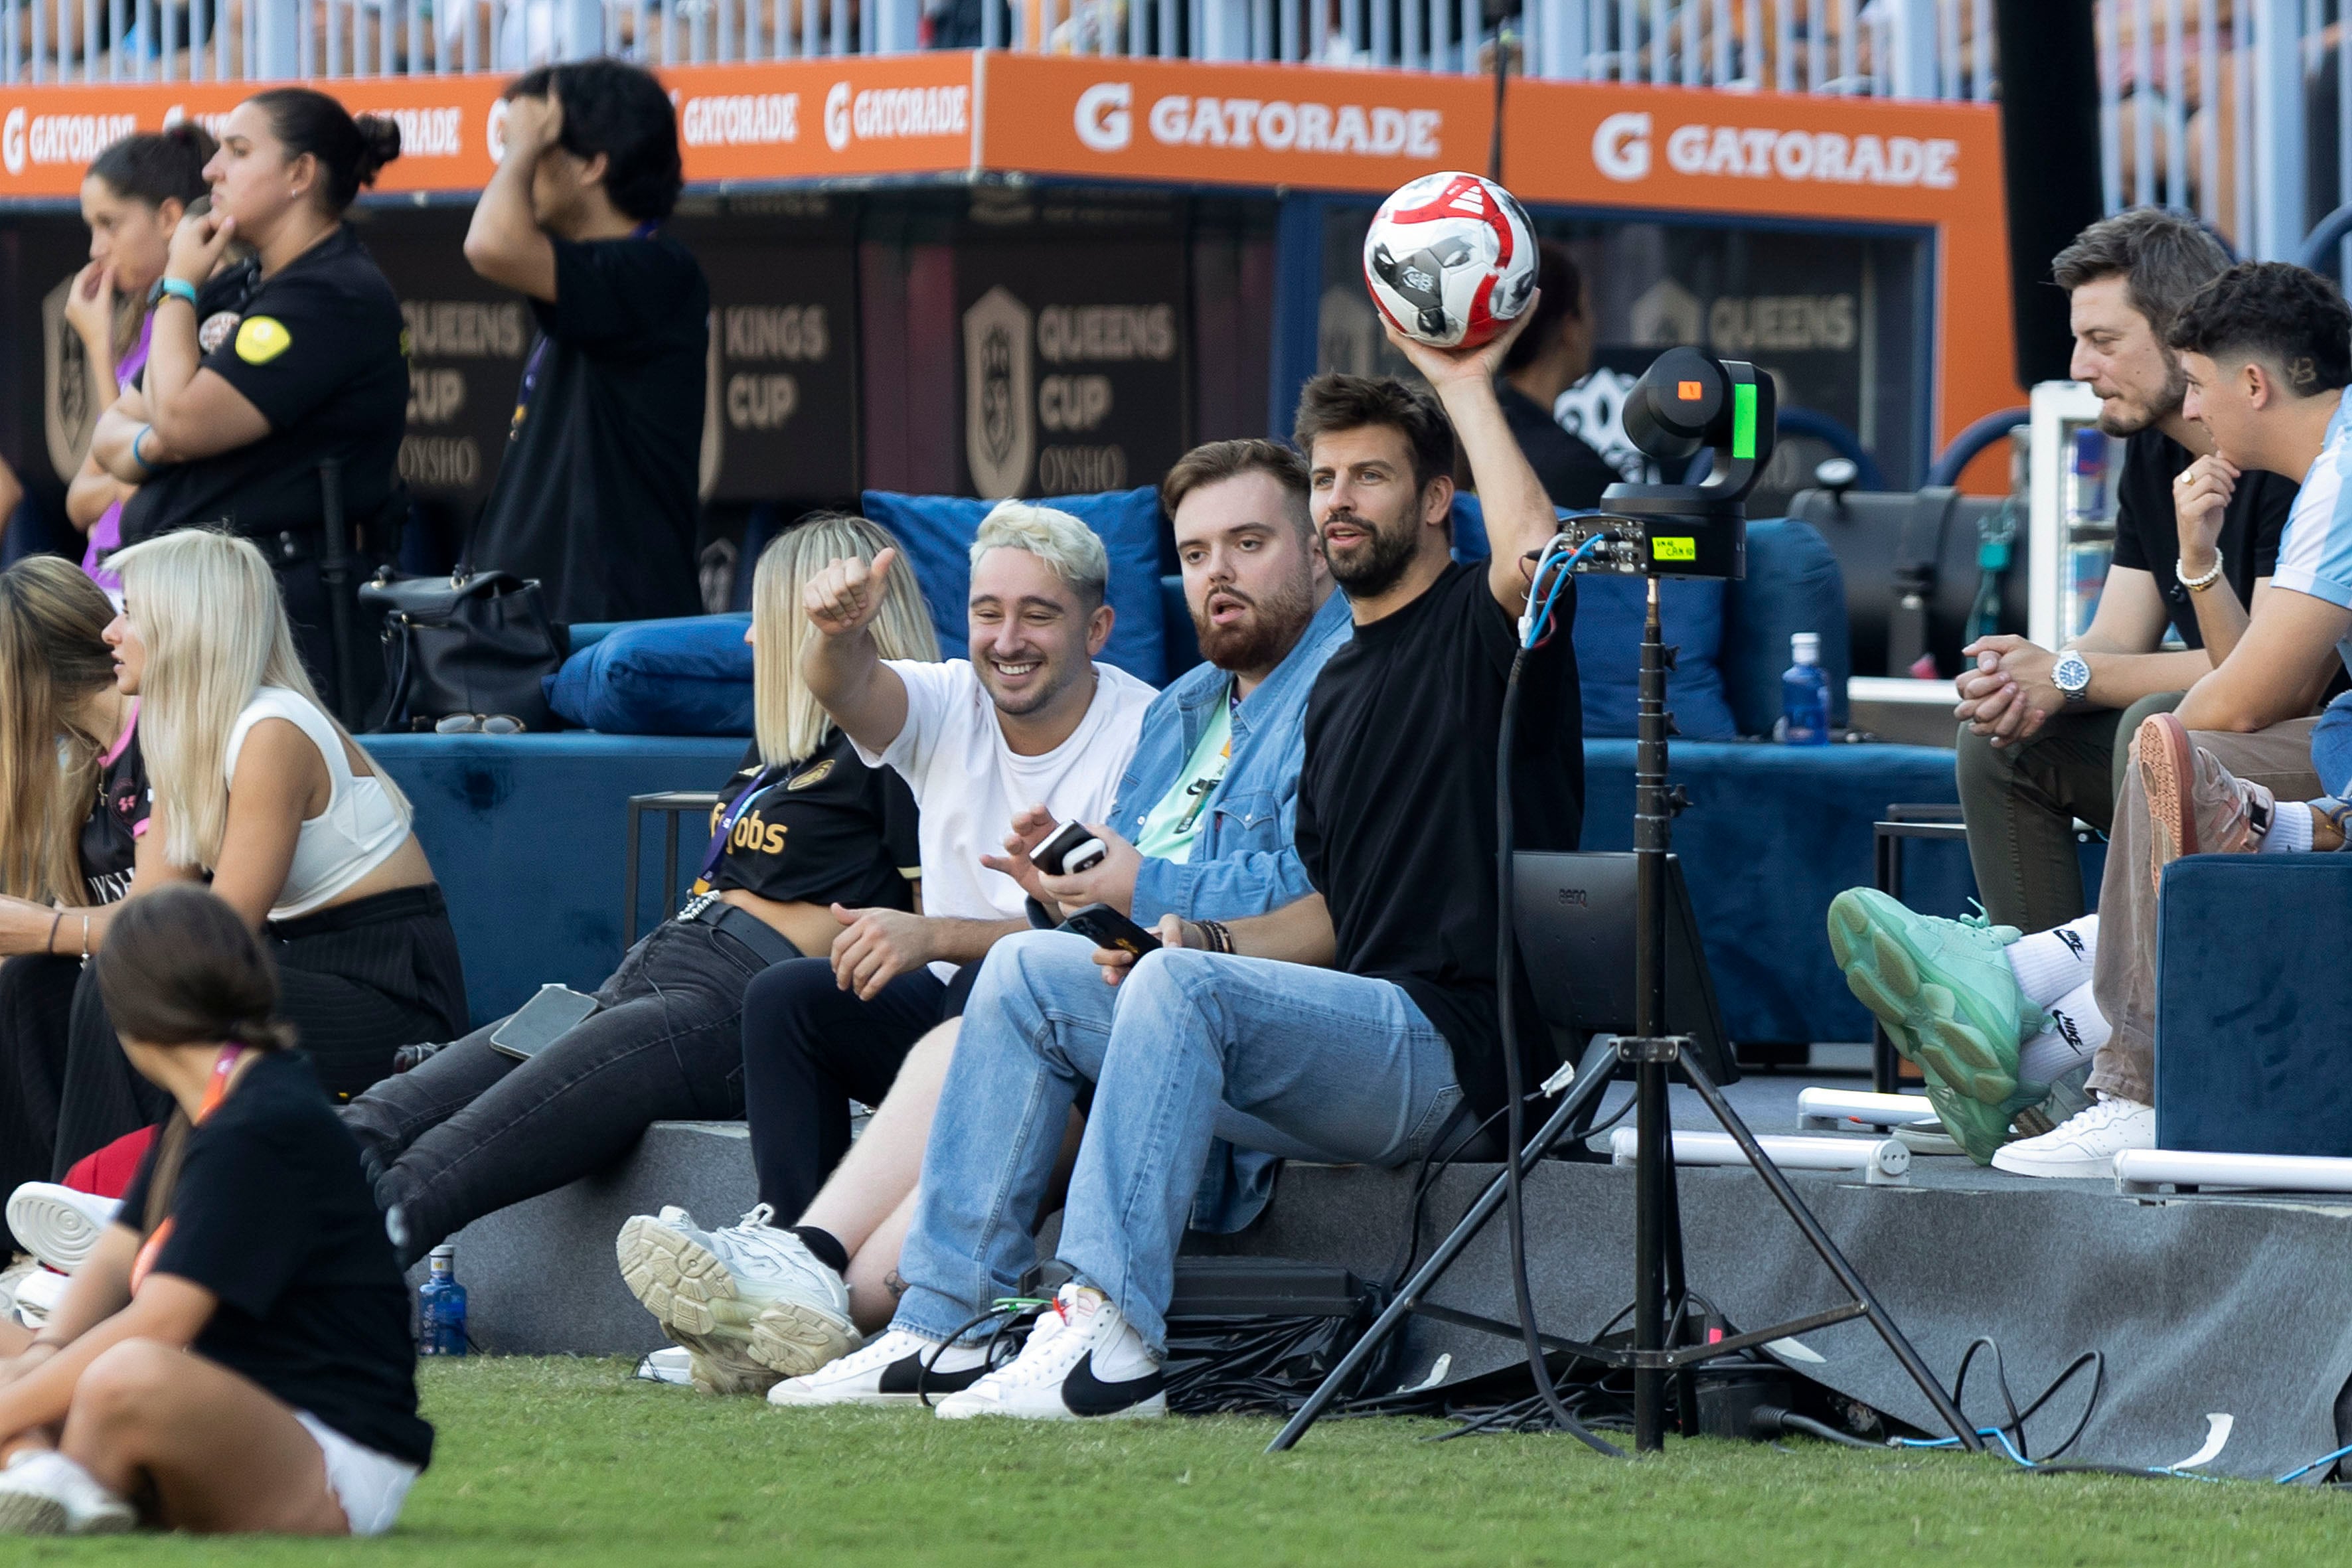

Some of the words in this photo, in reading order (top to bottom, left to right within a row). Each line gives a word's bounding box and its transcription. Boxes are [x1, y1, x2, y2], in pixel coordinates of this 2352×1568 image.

[3, 107, 26, 175] G
[684, 93, 799, 146] GATORADE
[824, 82, 852, 151] G
[853, 85, 969, 140] GATORADE
[1074, 82, 1132, 151] G
[1149, 95, 1442, 159] GATORADE
[1593, 112, 1653, 181] G
[1668, 125, 1960, 189] GATORADE
[728, 306, 825, 358] KINGS
[1040, 305, 1173, 360] QUEENS
[1711, 297, 1854, 349] QUEENS
[730, 375, 797, 428] CUP
[1040, 375, 1114, 430] CUP
[1042, 446, 1123, 493] OYSHO
[2063, 1016, 2083, 1046] NIKE
